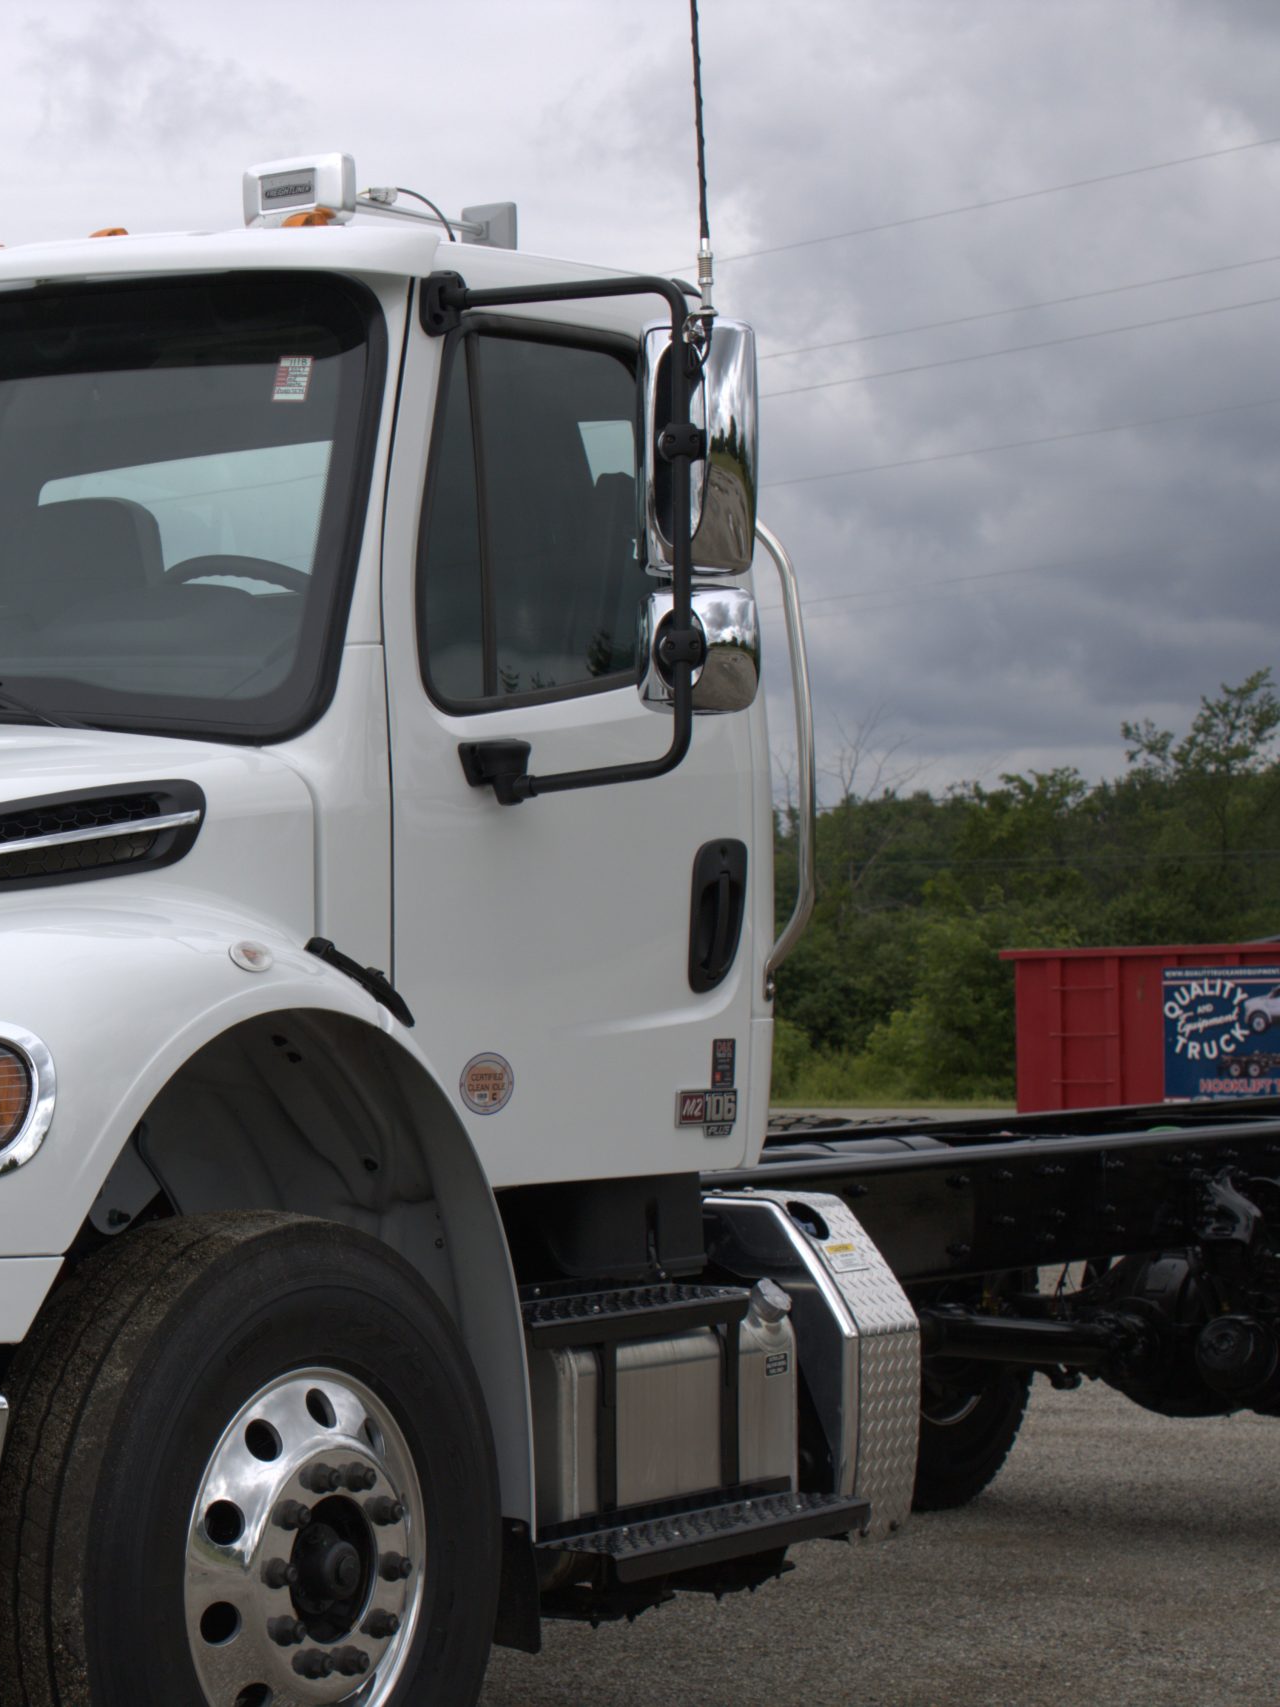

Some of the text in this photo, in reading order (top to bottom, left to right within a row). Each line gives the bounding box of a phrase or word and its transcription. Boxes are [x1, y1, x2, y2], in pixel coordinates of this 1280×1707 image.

[1164, 978, 1248, 1019] QUALITY
[1175, 1022, 1250, 1060] TRUCK
[683, 1092, 736, 1121] M2 106
[707, 1125, 731, 1136] PLUS
